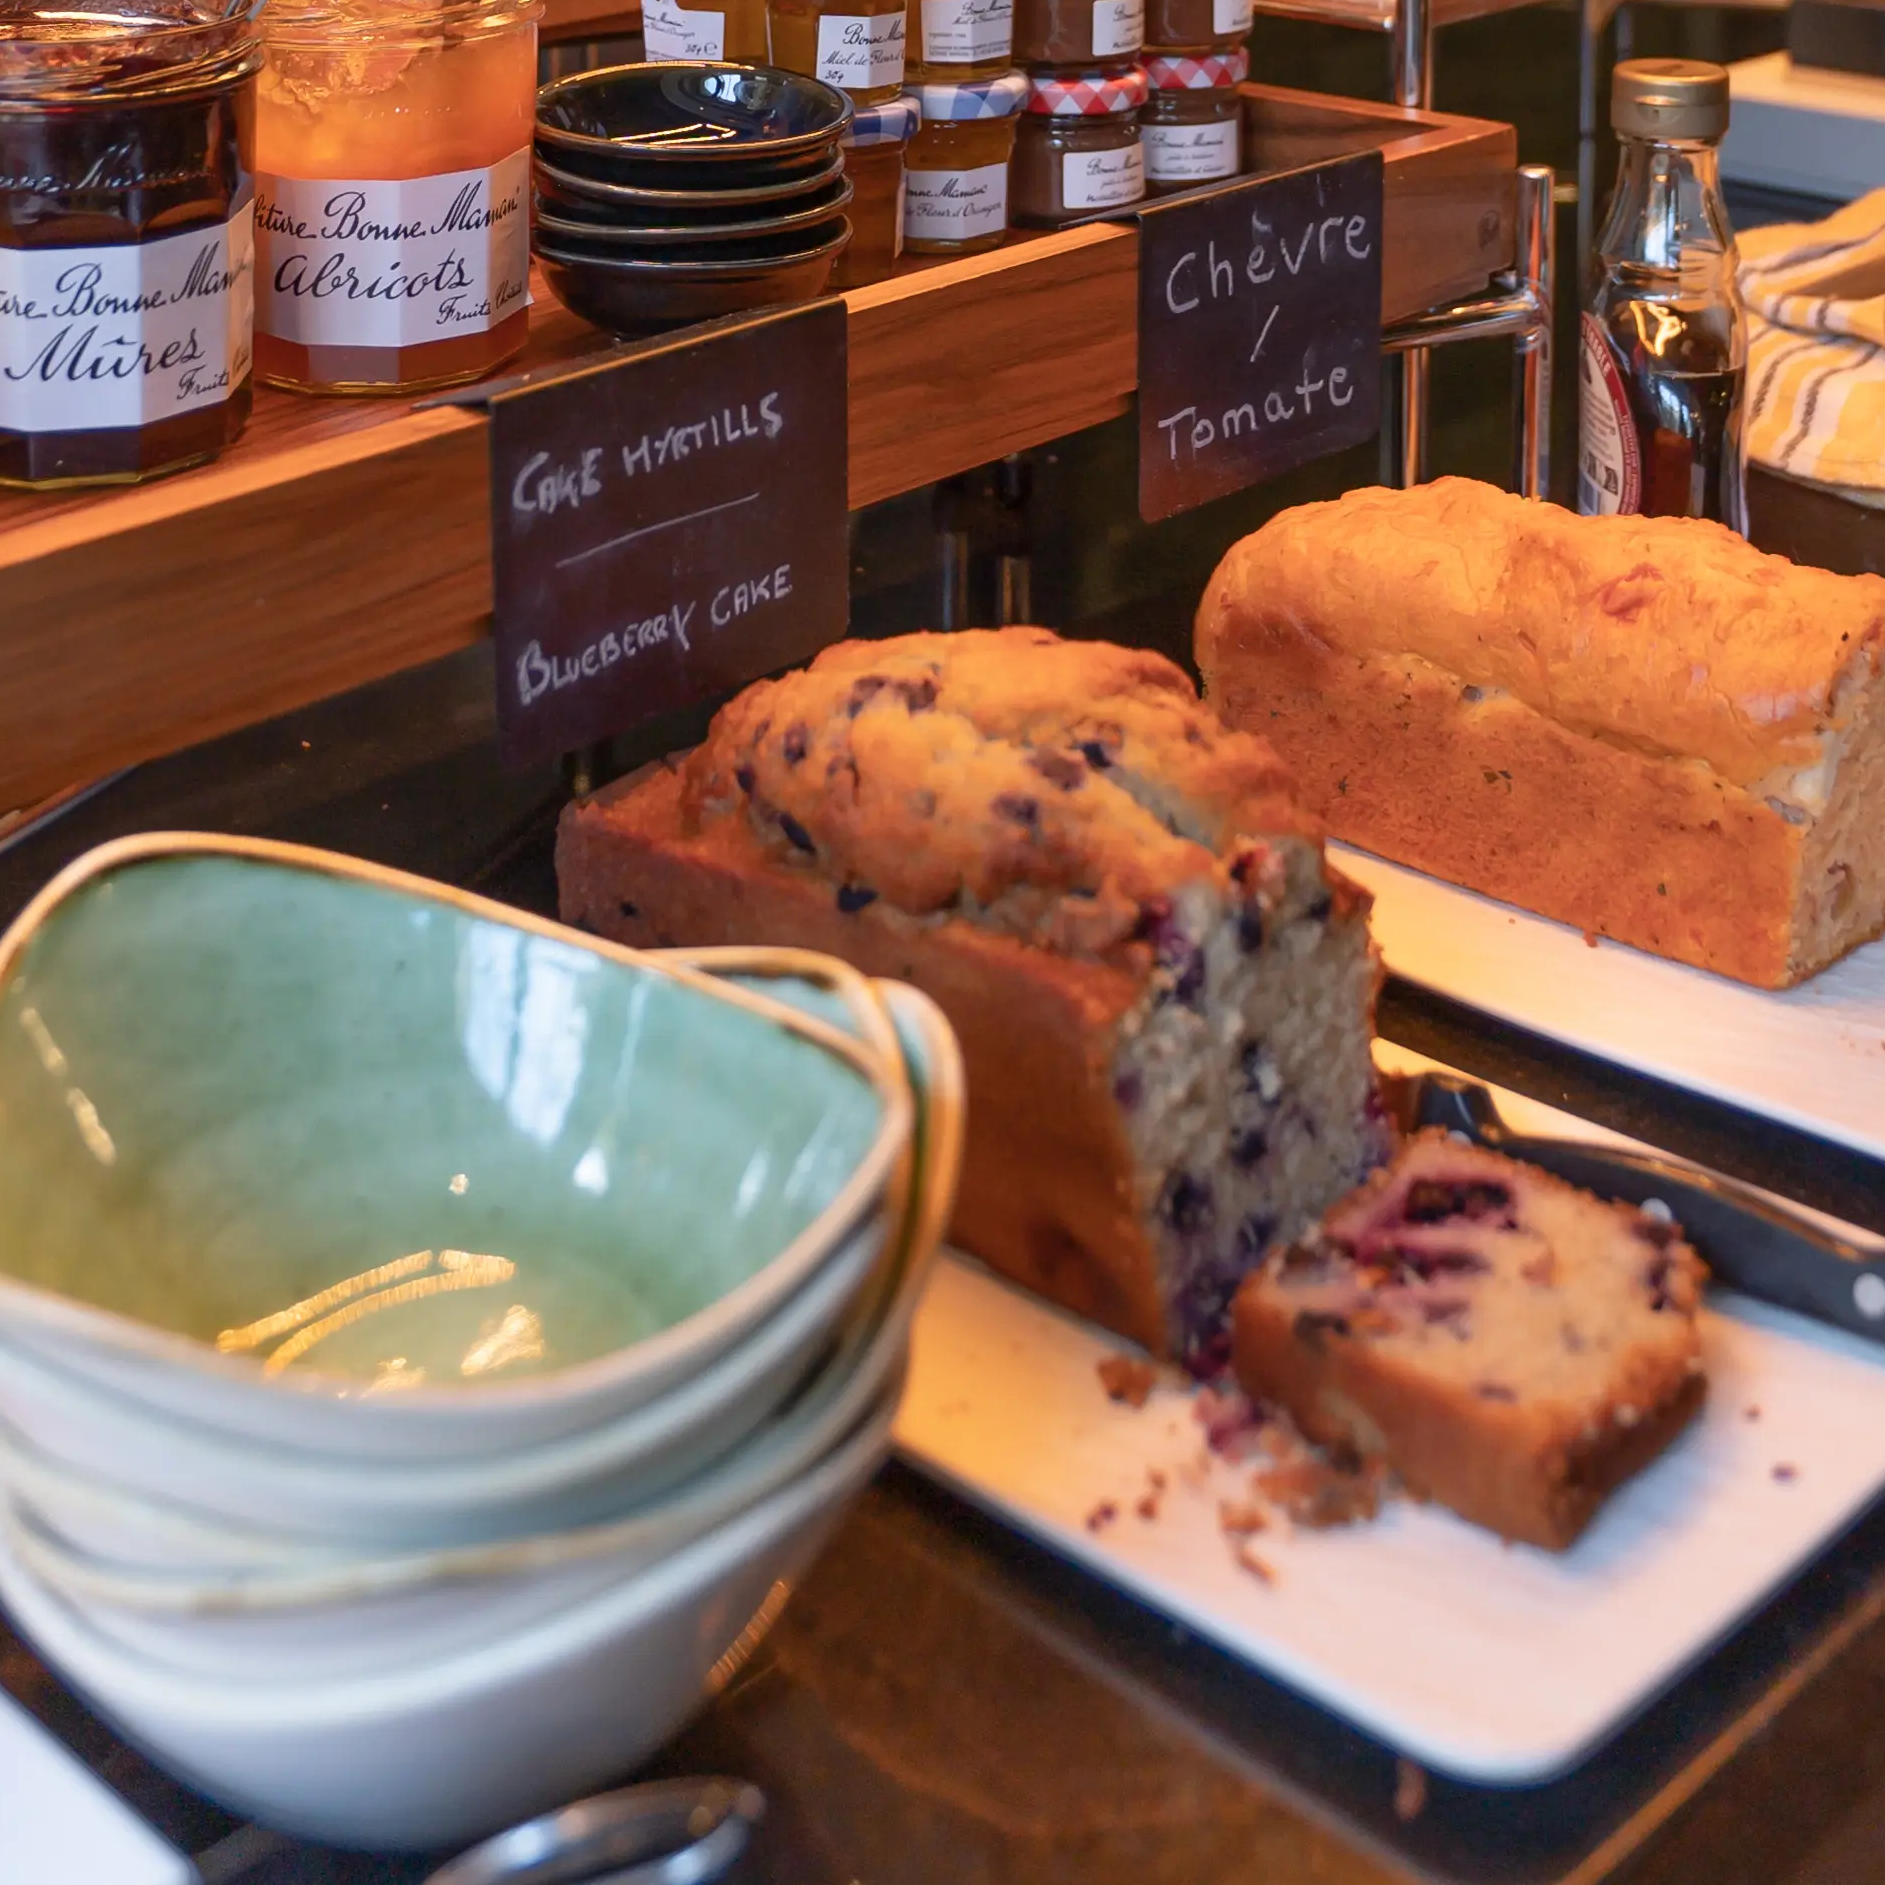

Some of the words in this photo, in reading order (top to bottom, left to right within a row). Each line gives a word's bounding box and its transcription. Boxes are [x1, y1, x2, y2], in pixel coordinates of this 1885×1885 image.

[822, 50, 852, 66] Miel
[842, 22, 884, 45] Bonne
[320, 190, 426, 241] Bonne
[430, 179, 518, 236] Maman
[51, 262, 166, 318] Bonne
[273, 247, 474, 301] Abricots
[1166, 212, 1371, 315] Chèvre
[435, 293, 492, 326] Fruits
[3, 323, 206, 383] Mûres
[1157, 365, 1354, 461] Tomate
[512, 446, 604, 515] CAKE
[516, 598, 698, 707] BLUEBERRY
[710, 563, 794, 627] CAKE
